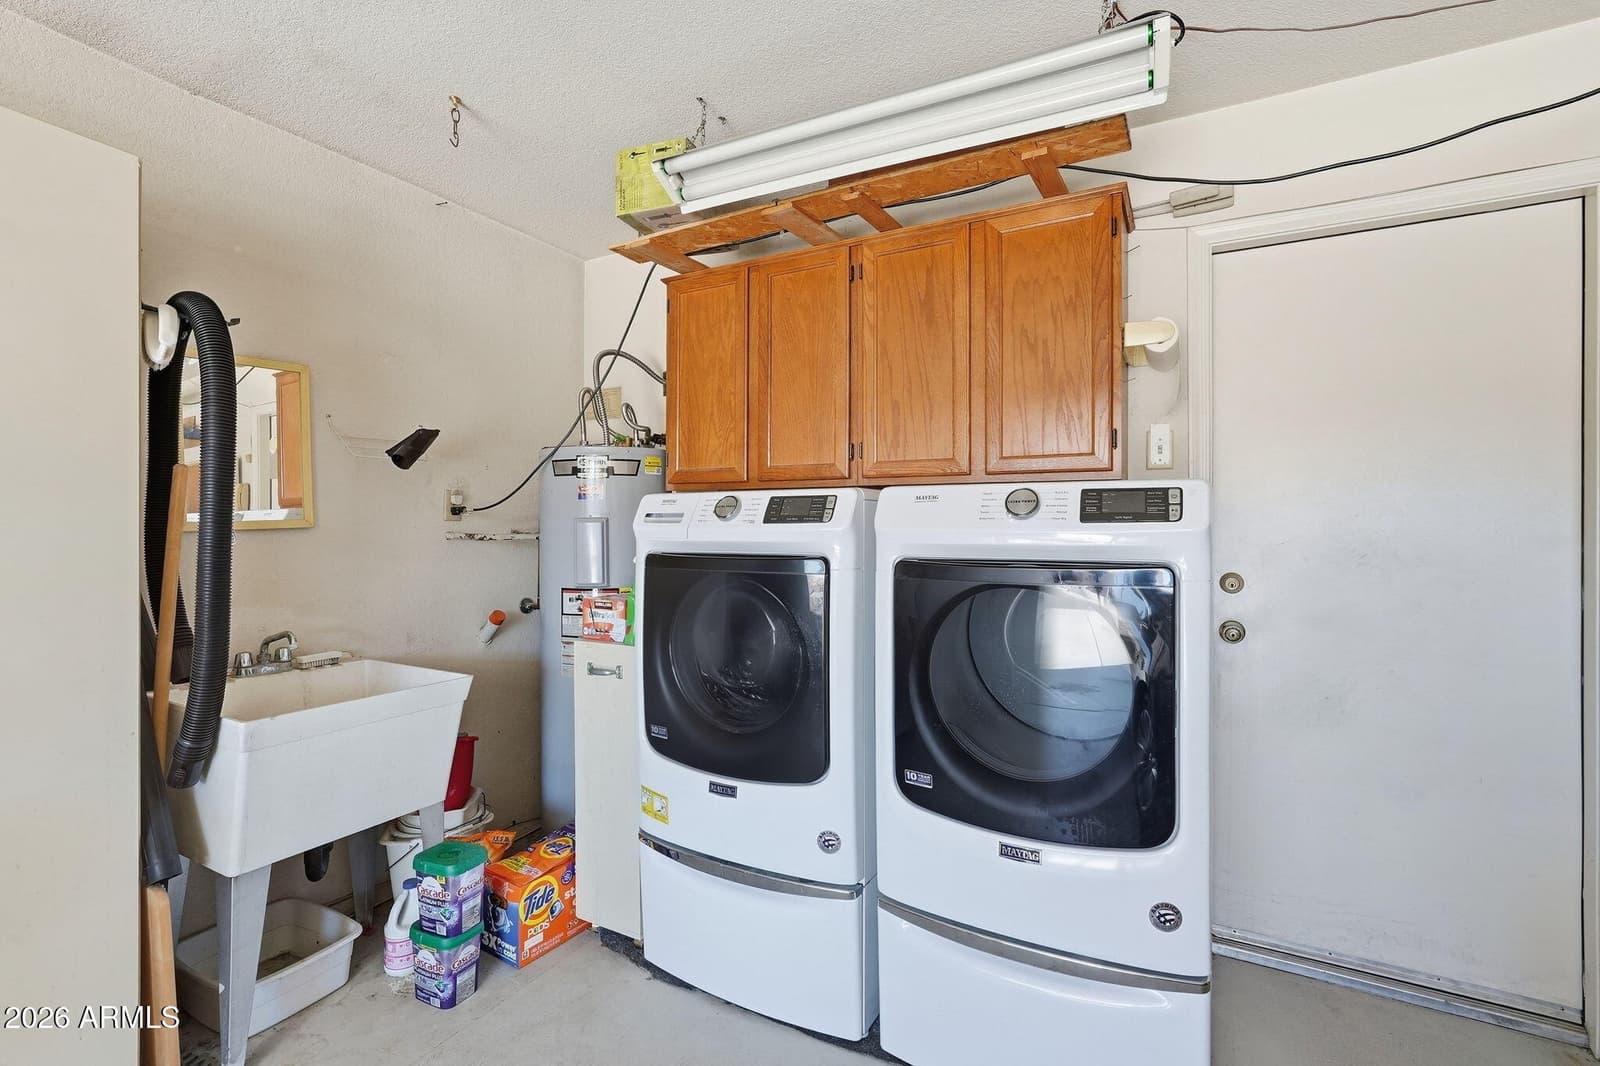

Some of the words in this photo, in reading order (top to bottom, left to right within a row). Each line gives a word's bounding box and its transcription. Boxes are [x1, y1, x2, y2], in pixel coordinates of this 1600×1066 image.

[907, 771, 917, 781] 10
[1002, 846, 1039, 861] MAYTAG
[416, 884, 451, 900] Cascade
[524, 885, 555, 922] Tide
[482, 931, 497, 951] 3X
[414, 956, 445, 974] Cascade
